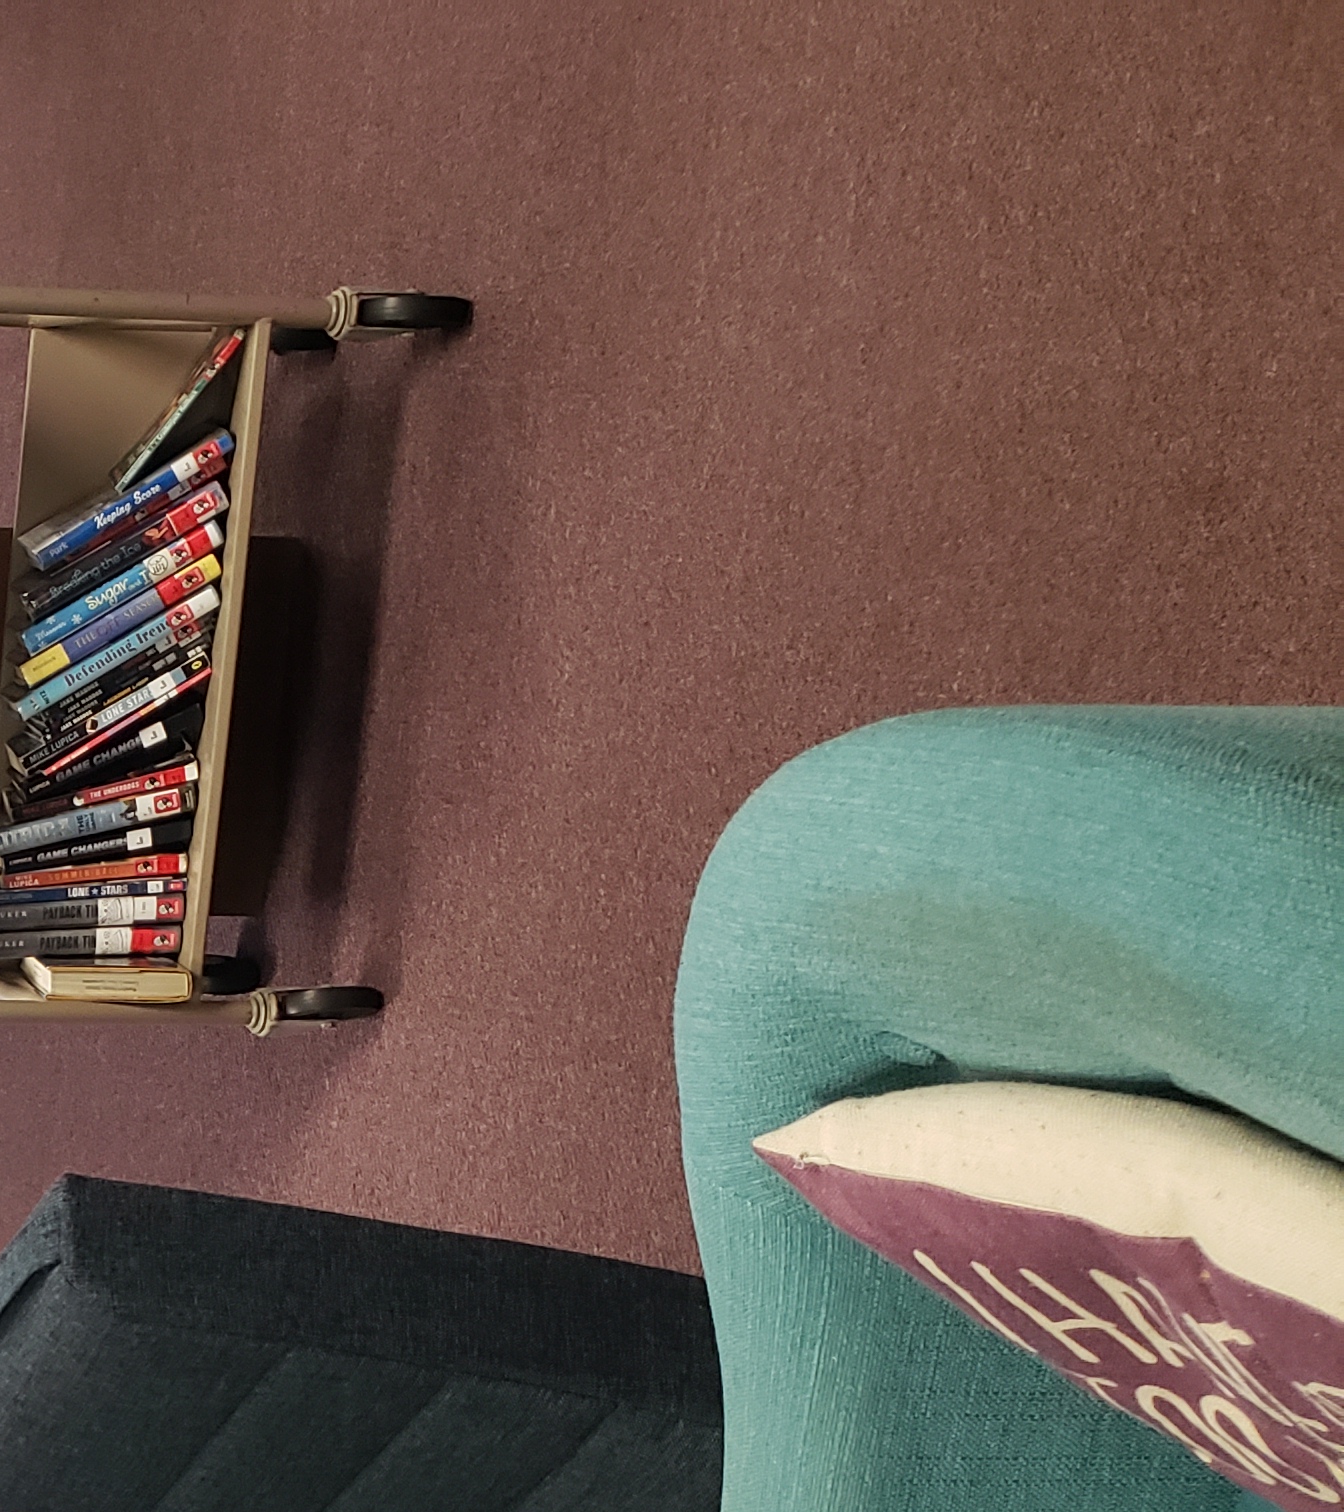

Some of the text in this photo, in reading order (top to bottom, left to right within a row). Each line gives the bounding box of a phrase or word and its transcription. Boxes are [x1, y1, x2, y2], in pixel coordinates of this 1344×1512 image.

[49, 484, 162, 557] Park Keeping Score
[49, 543, 142, 597] Breaking the Ice
[85, 577, 129, 611] Sugar
[73, 617, 121, 650] THE OFF
[64, 639, 137, 688] Defending
[29, 704, 124, 764] MIKE LUPICA LONE
[29, 758, 91, 794] LUPICA GAME
[89, 780, 141, 799] THE UNDERDOGS
[76, 815, 84, 834] THE
[37, 847, 69, 862] GAME
[9, 878, 40, 888] LUPICA
[67, 884, 128, 898] LONE STARS
[42, 905, 83, 922] PAYBACK
[39, 934, 80, 951] PAYBACK
